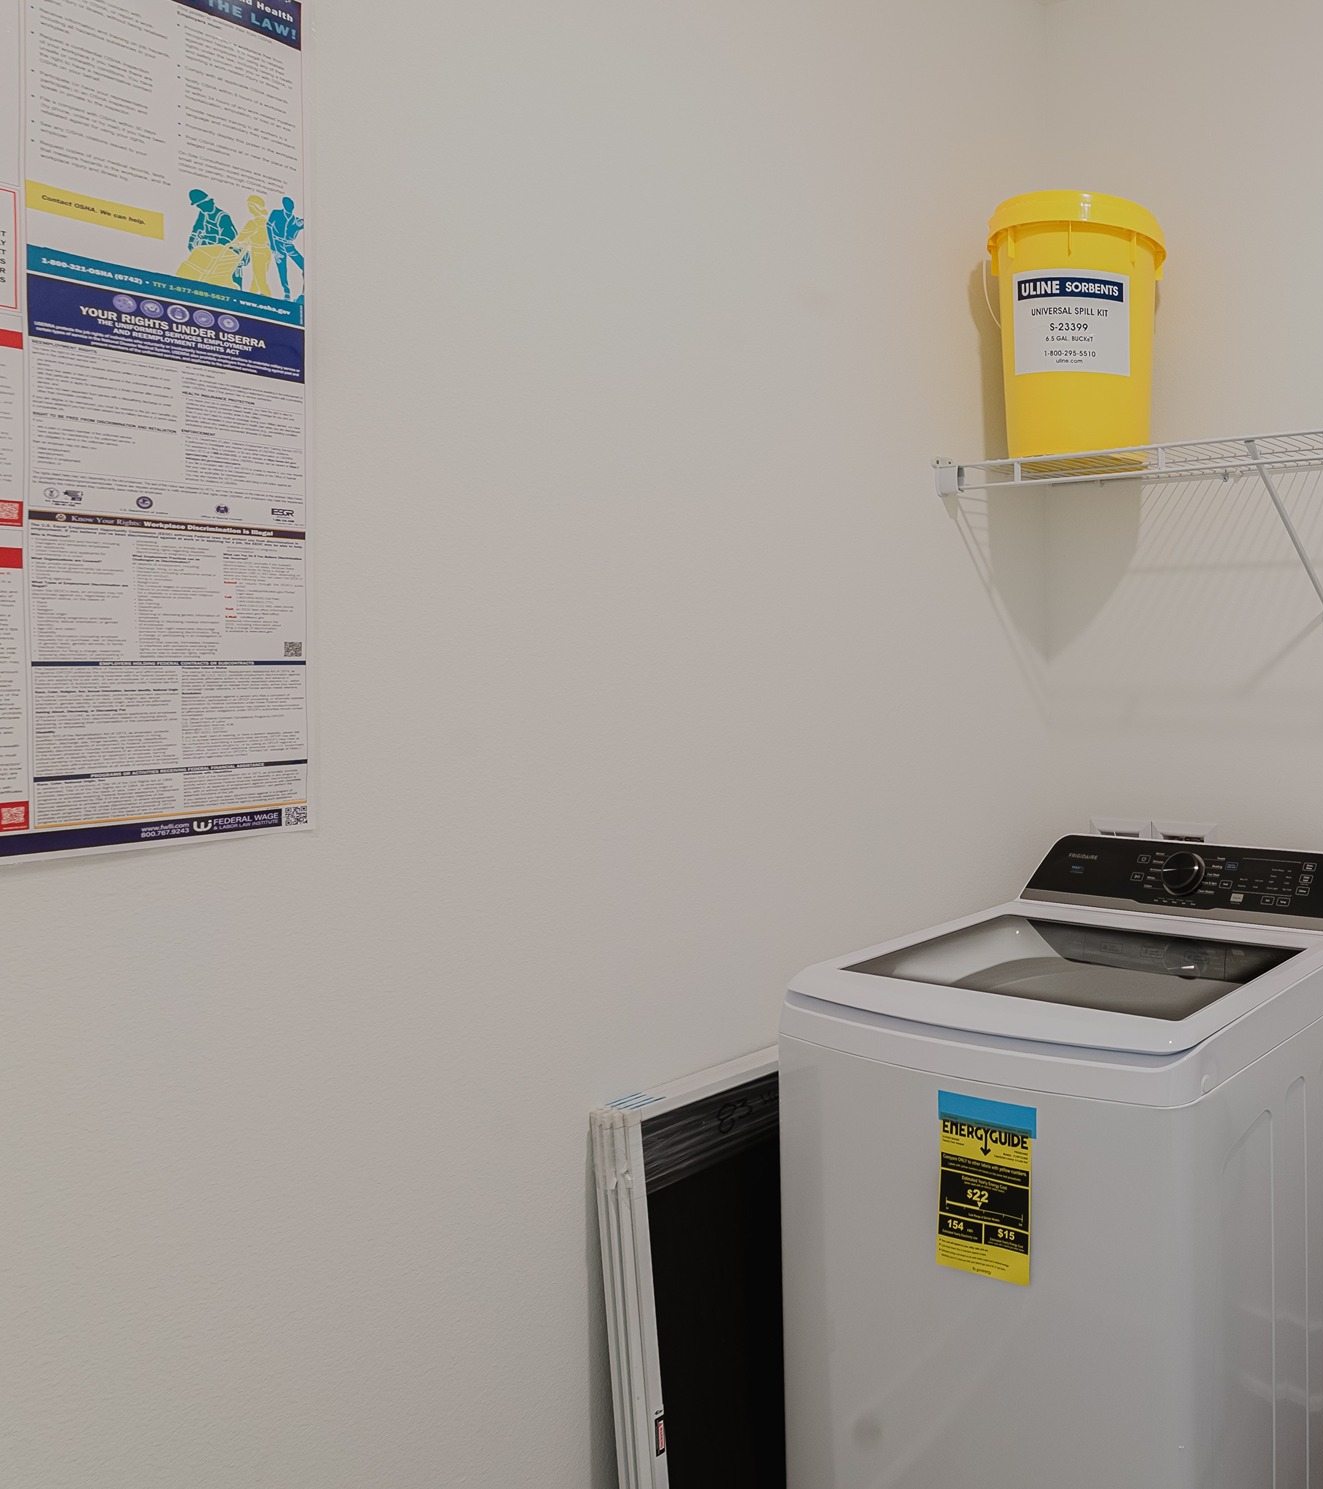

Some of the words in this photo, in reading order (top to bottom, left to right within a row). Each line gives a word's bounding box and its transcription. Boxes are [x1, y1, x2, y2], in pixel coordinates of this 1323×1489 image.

[257, 1, 293, 22] Health
[208, 0, 242, 18] THE
[250, 12, 296, 40] LAW!
[42, 195, 72, 207] Contact
[74, 203, 97, 213] OSHA.
[129, 216, 146, 225] help.
[41, 258, 113, 278] 1-800-321-OSHA
[114, 273, 143, 285] (6742)
[153, 281, 166, 289] TTY
[169, 285, 230, 301] 1-877-889-5627
[240, 300, 290, 315] www.osha.gov
[1021, 280, 1060, 296] ULINE
[1065, 281, 1119, 296] SORBENTS
[1031, 307, 1072, 316] UNIVERSAL
[1074, 307, 1094, 316] SPILL
[1097, 309, 1108, 317] KIT
[80, 306, 118, 320] YOUR
[121, 314, 169, 330] RIGHTS
[172, 322, 216, 339] UNDER
[219, 332, 266, 349] USERRA
[1050, 323, 1088, 331] S-23399
[97, 318, 114, 327] THE
[114, 322, 164, 336] UNIFORMED
[164, 330, 202, 343] SERVICES
[204, 338, 253, 352] EMPLOYMENT
[113, 328, 130, 336] AND
[132, 331, 196, 348] REEMPLOYMENT
[198, 343, 224, 353] RIGHTS
[226, 348, 240, 356] ACT
[271, 508, 294, 517] ESGR
[143, 521, 185, 530] Workplace
[187, 525, 241, 534] Discrimination
[214, 815, 251, 826] FEDERAL
[254, 812, 279, 821] WAGE
[141, 828, 190, 838] 800.767.9243
[942, 1120, 1028, 1150] ENERGYGUIDE
[967, 1188, 989, 1203] $22
[947, 1219, 964, 1231] 154
[997, 1228, 1015, 1240] $15
